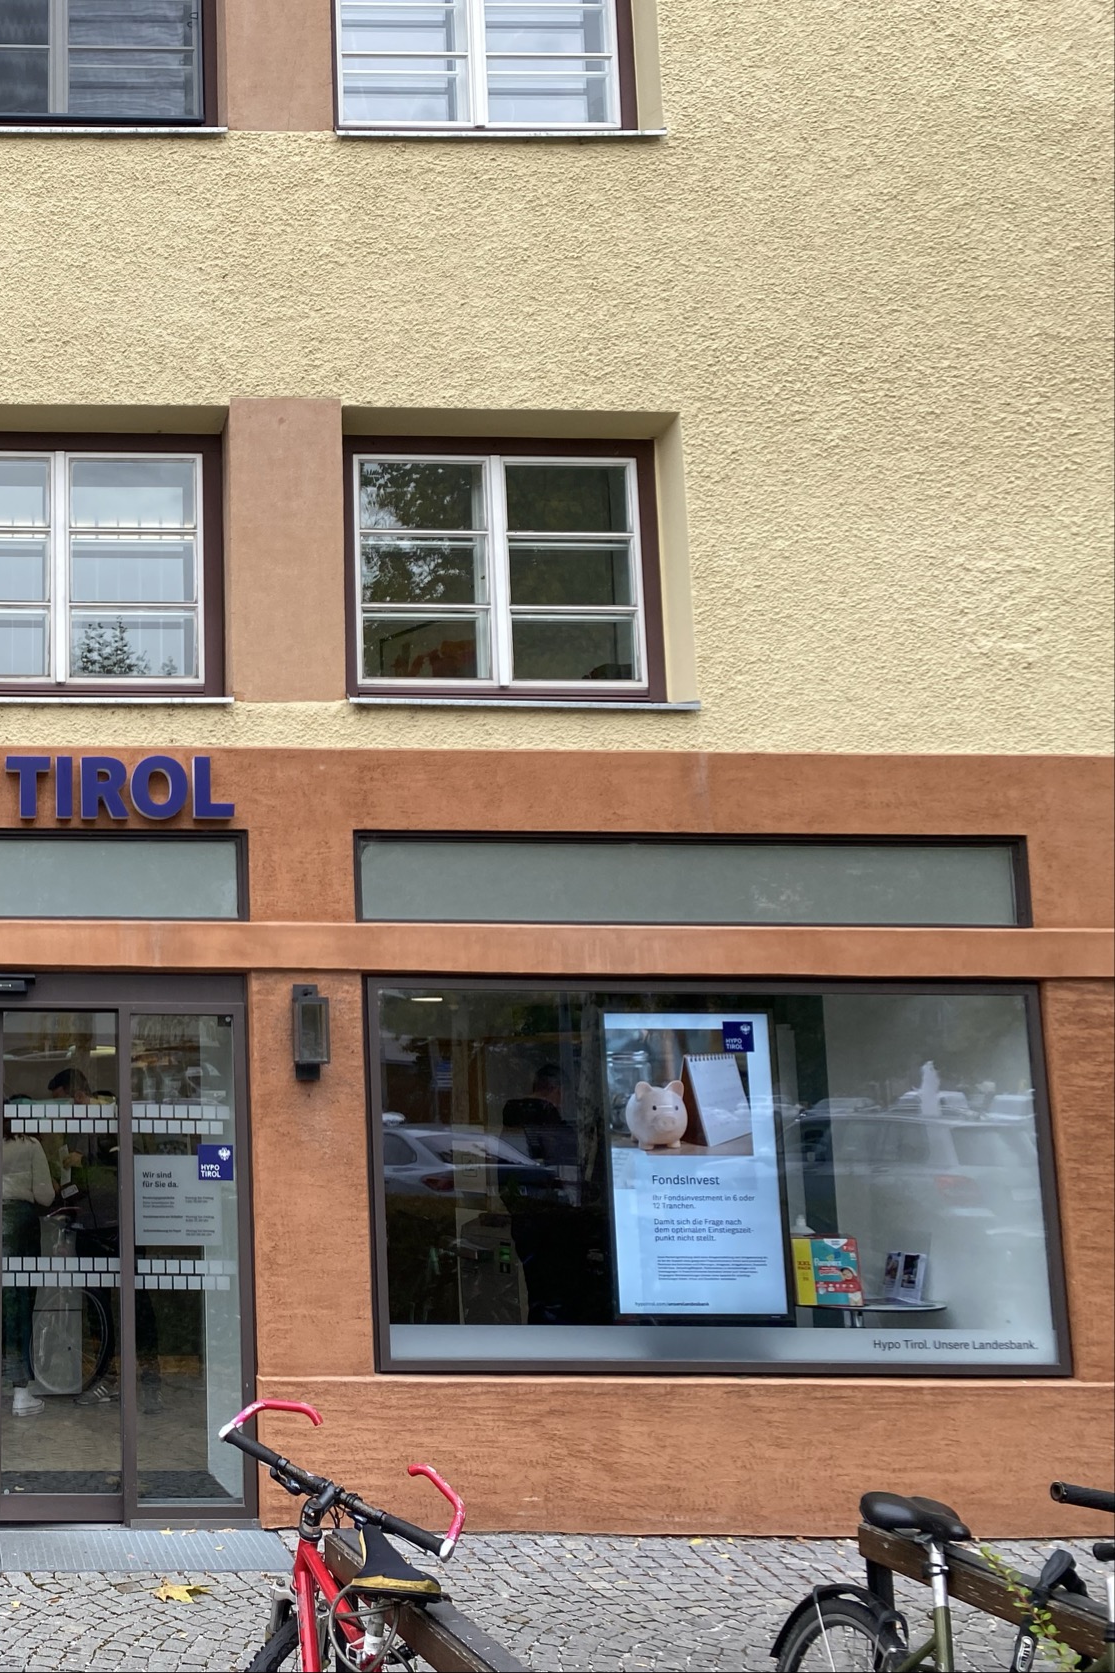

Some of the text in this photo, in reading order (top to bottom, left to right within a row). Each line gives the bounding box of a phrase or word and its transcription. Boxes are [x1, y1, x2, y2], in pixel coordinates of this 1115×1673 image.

[5, 755, 235, 820] TIROL
[200, 1170, 221, 1178] TIROL
[651, 1174, 721, 1185] FondsInvest
[704, 1218, 724, 1227] Frage
[671, 1226, 706, 1235] optimalen
[708, 1226, 754, 1235] Einstiegszeit-
[655, 1234, 675, 1242] punkt
[873, 1339, 1039, 1351] Hypo Tirol. Unsere Landesbank.
